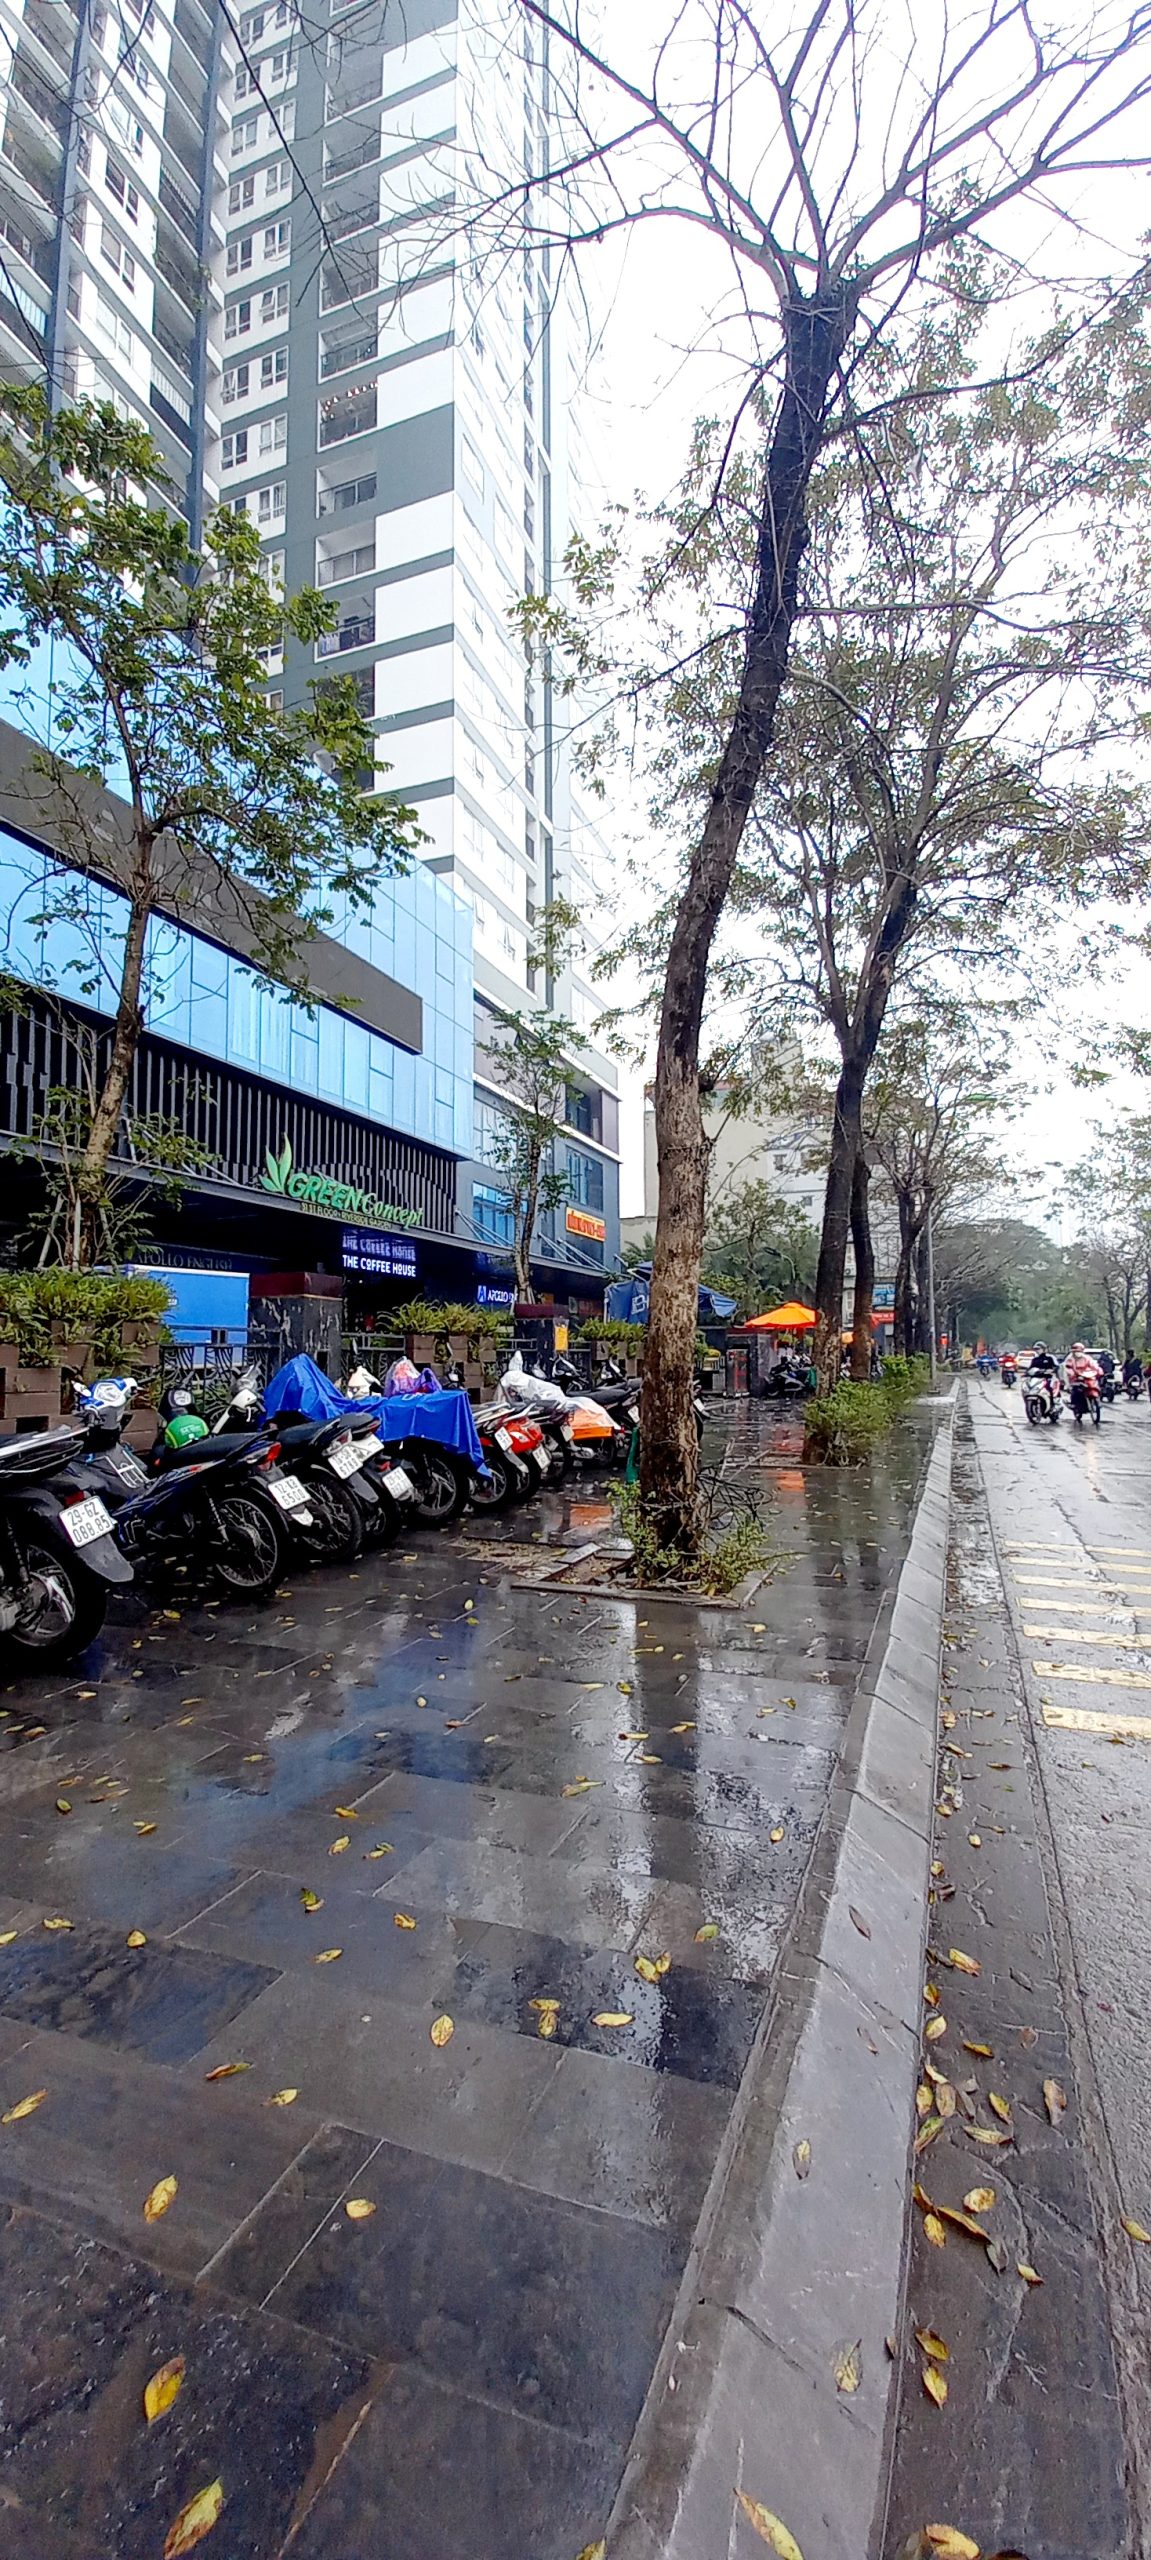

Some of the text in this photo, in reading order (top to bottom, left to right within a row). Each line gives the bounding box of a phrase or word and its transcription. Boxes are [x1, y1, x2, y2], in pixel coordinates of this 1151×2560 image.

[288, 1172, 424, 1229] GREEN Concept
[342, 1254, 416, 1277] THE COFFEE HOUSE
[73, 1515, 111, 1543] 088.85
